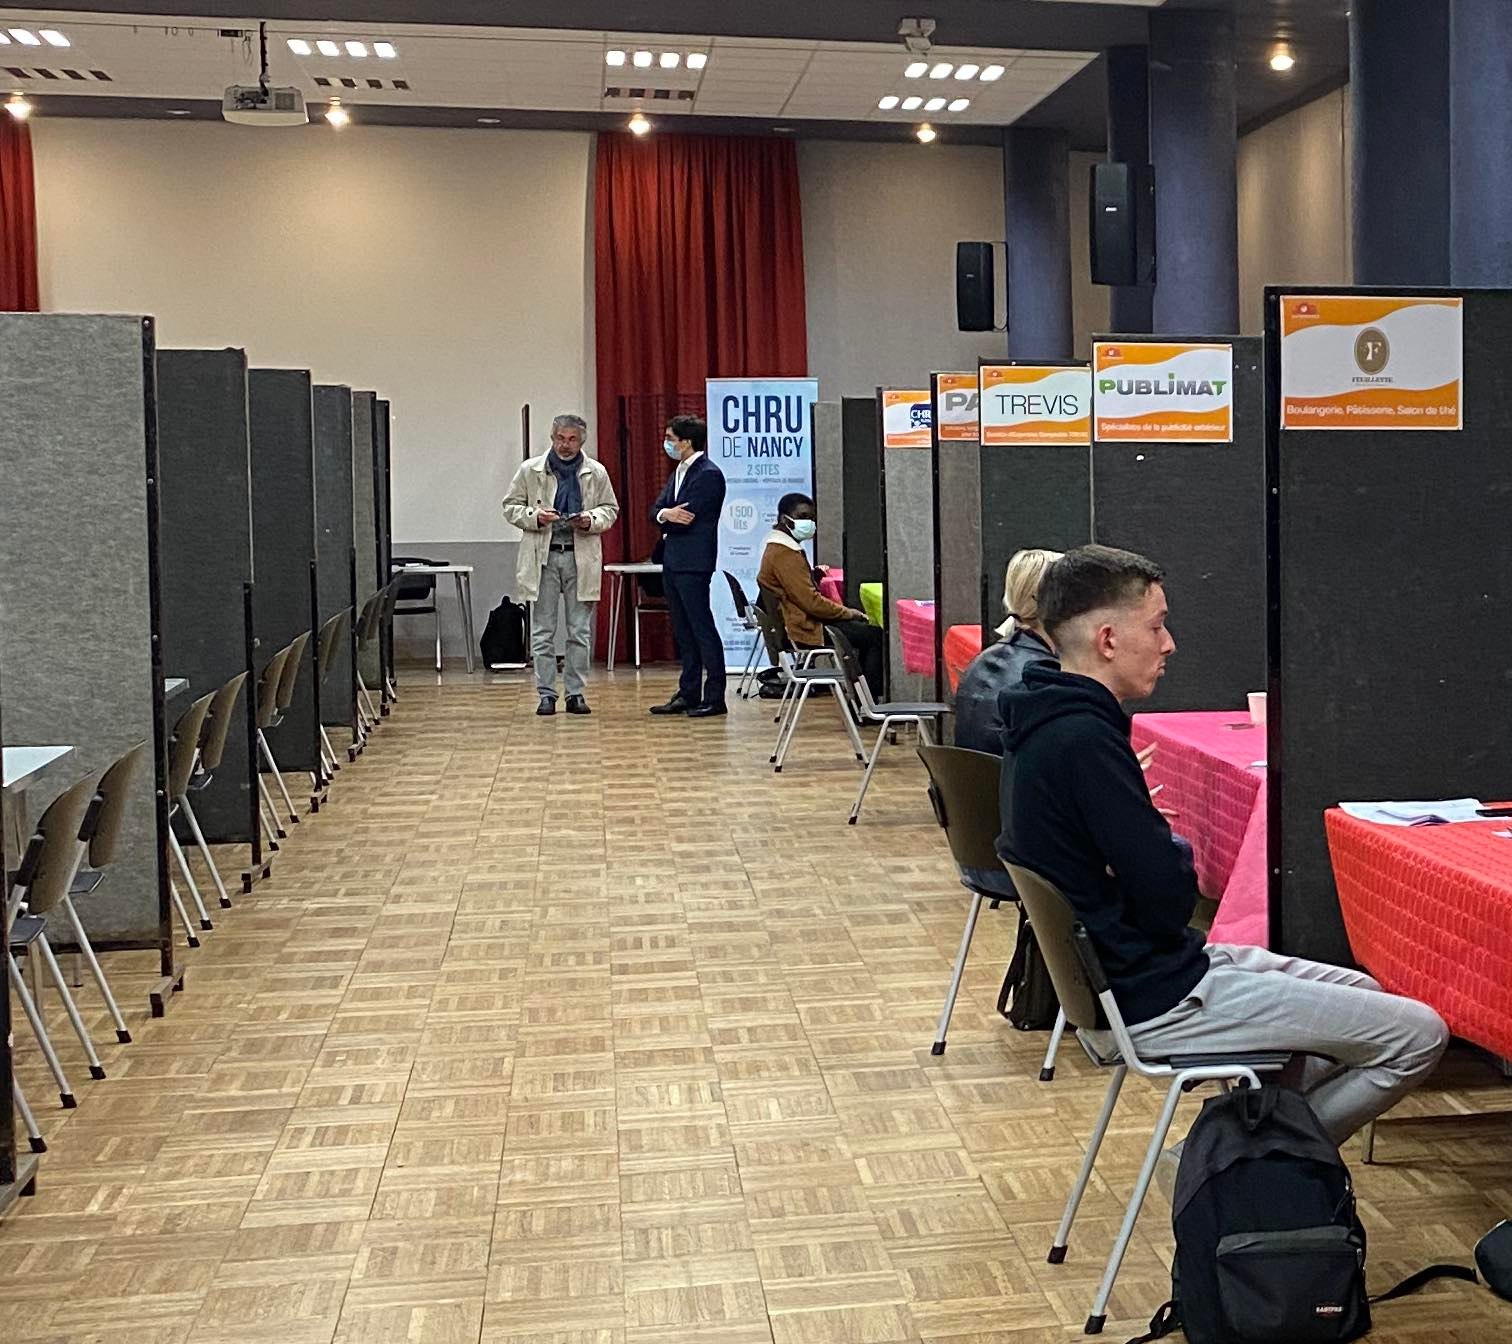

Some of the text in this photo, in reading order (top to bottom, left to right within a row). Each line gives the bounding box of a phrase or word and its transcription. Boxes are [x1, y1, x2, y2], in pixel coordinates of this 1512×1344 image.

[1365, 342, 1382, 361] F
[722, 395, 803, 433] CHRU
[995, 394, 1078, 415] TREVIS
[1397, 405, 1424, 415] Salon
[1426, 405, 1437, 415] de
[1439, 405, 1456, 415] thé
[723, 437, 804, 457] DE NANCY
[747, 464, 780, 475] 2 SITES
